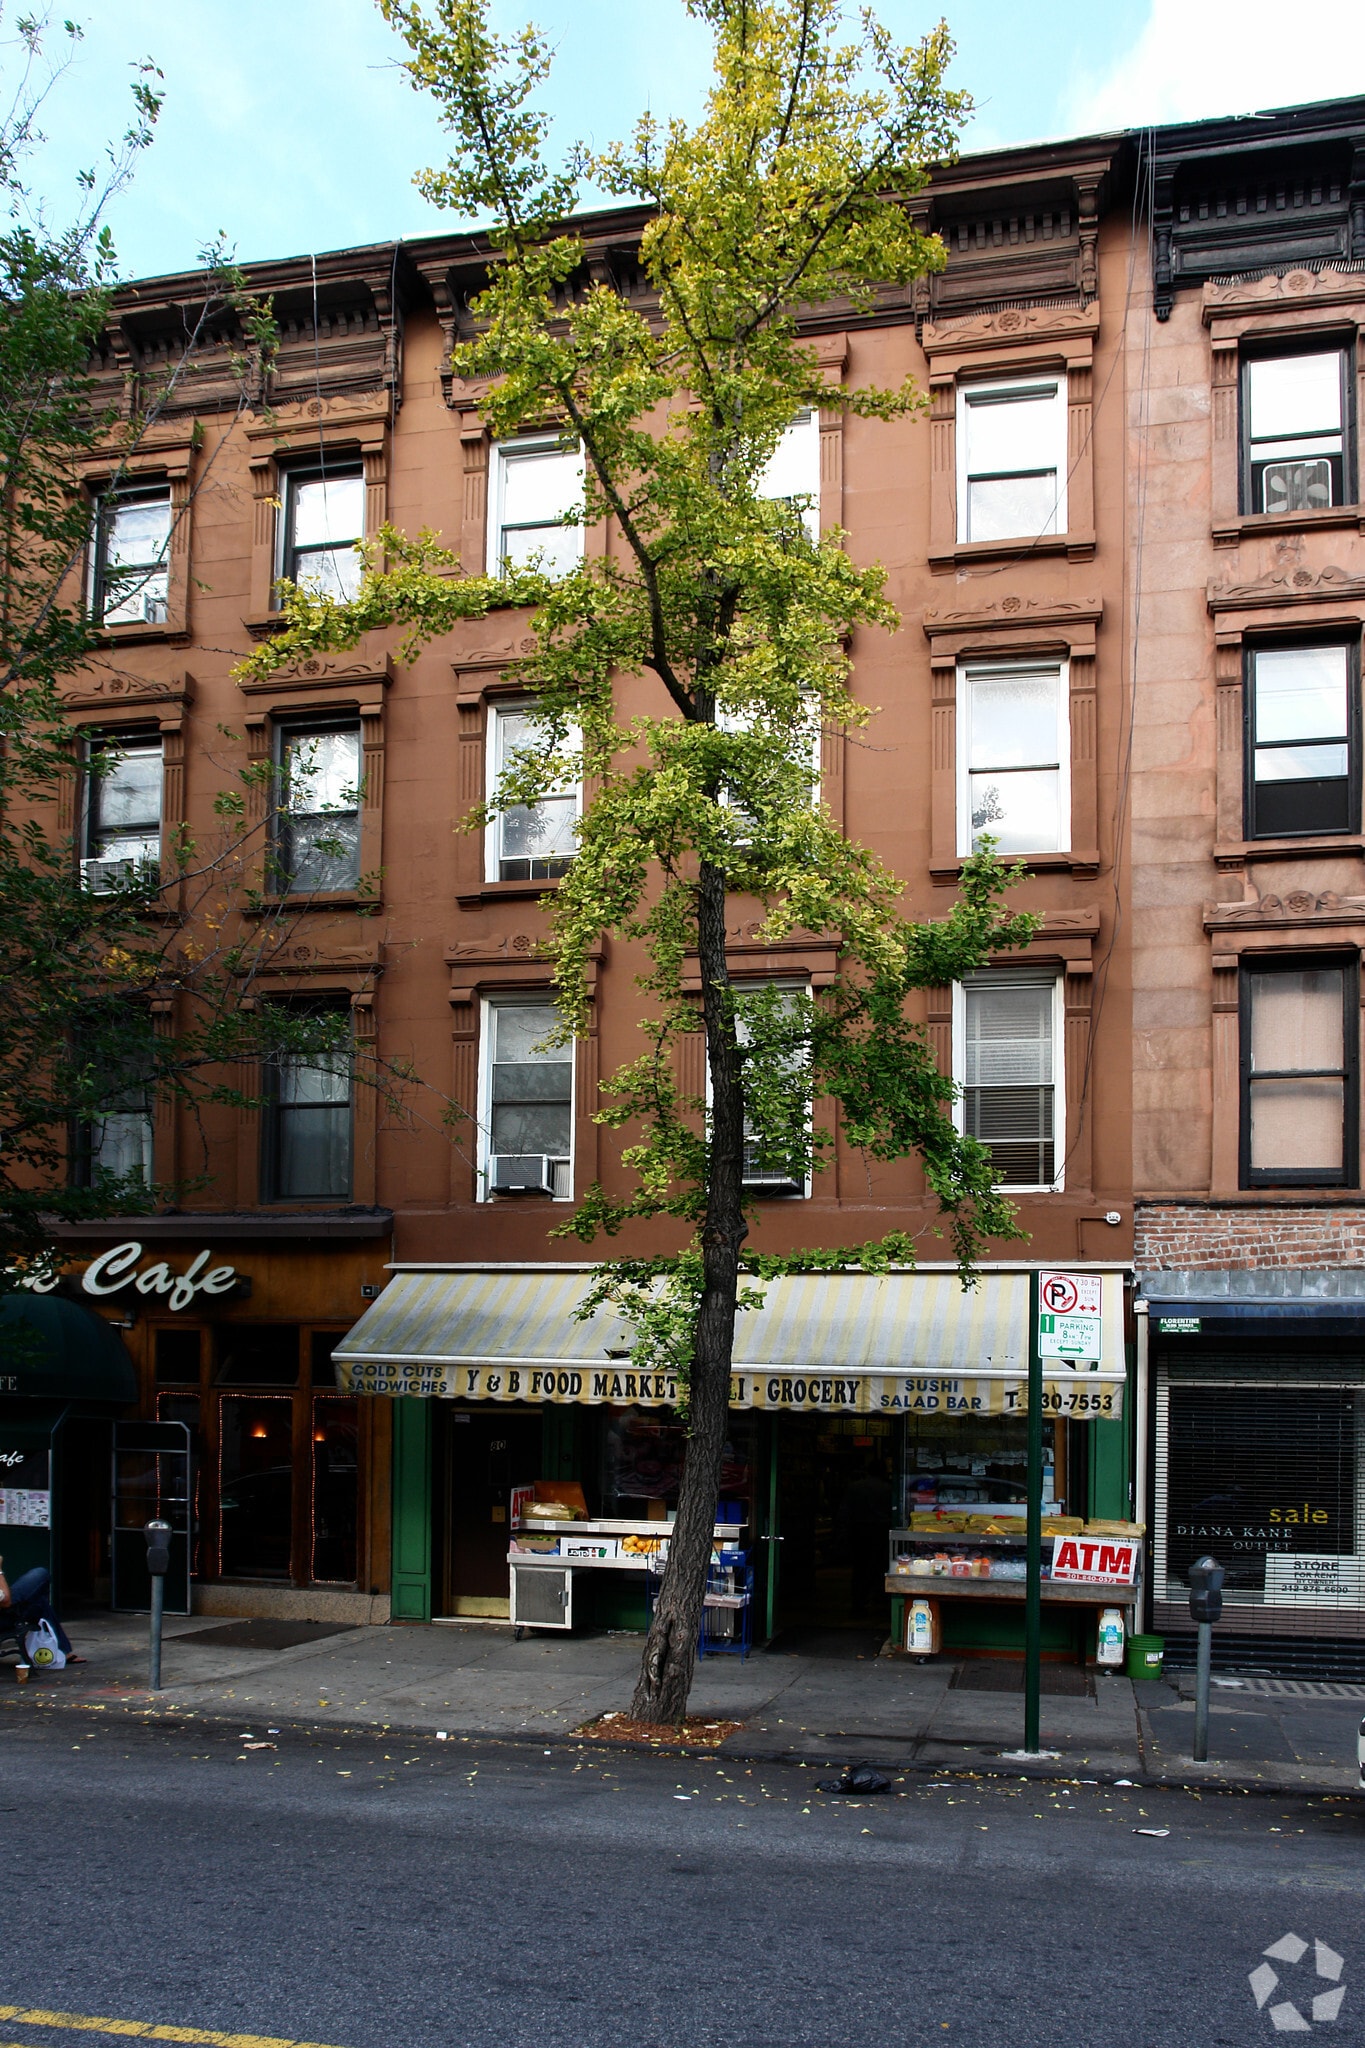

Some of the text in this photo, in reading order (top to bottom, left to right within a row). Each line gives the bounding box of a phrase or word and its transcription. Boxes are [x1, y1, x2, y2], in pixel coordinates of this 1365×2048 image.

[82, 1241, 236, 1311] Cafe
[1045, 1316, 1050, 1333] 1
[1059, 1322, 1094, 1331] PARKING
[352, 1365, 442, 1378] COLD CUTS
[348, 1379, 447, 1392] SANDWICHES
[467, 1369, 479, 1392] Y
[486, 1374, 501, 1392] &
[508, 1371, 520, 1393] B
[531, 1371, 582, 1395] FOOD
[593, 1373, 678, 1399] MARKET
[767, 1377, 860, 1404] GROCERY
[905, 1379, 958, 1393] SUSHI
[880, 1394, 982, 1409] SALAD BAR
[1042, 1393, 1113, 1410] 30-7553
[1269, 1503, 1328, 1524] sale
[1177, 1525, 1293, 1538] DIANA KANE
[1232, 1541, 1292, 1551] OUTLET
[1055, 1542, 1132, 1574] ATM
[1293, 1560, 1340, 1571] STORE
